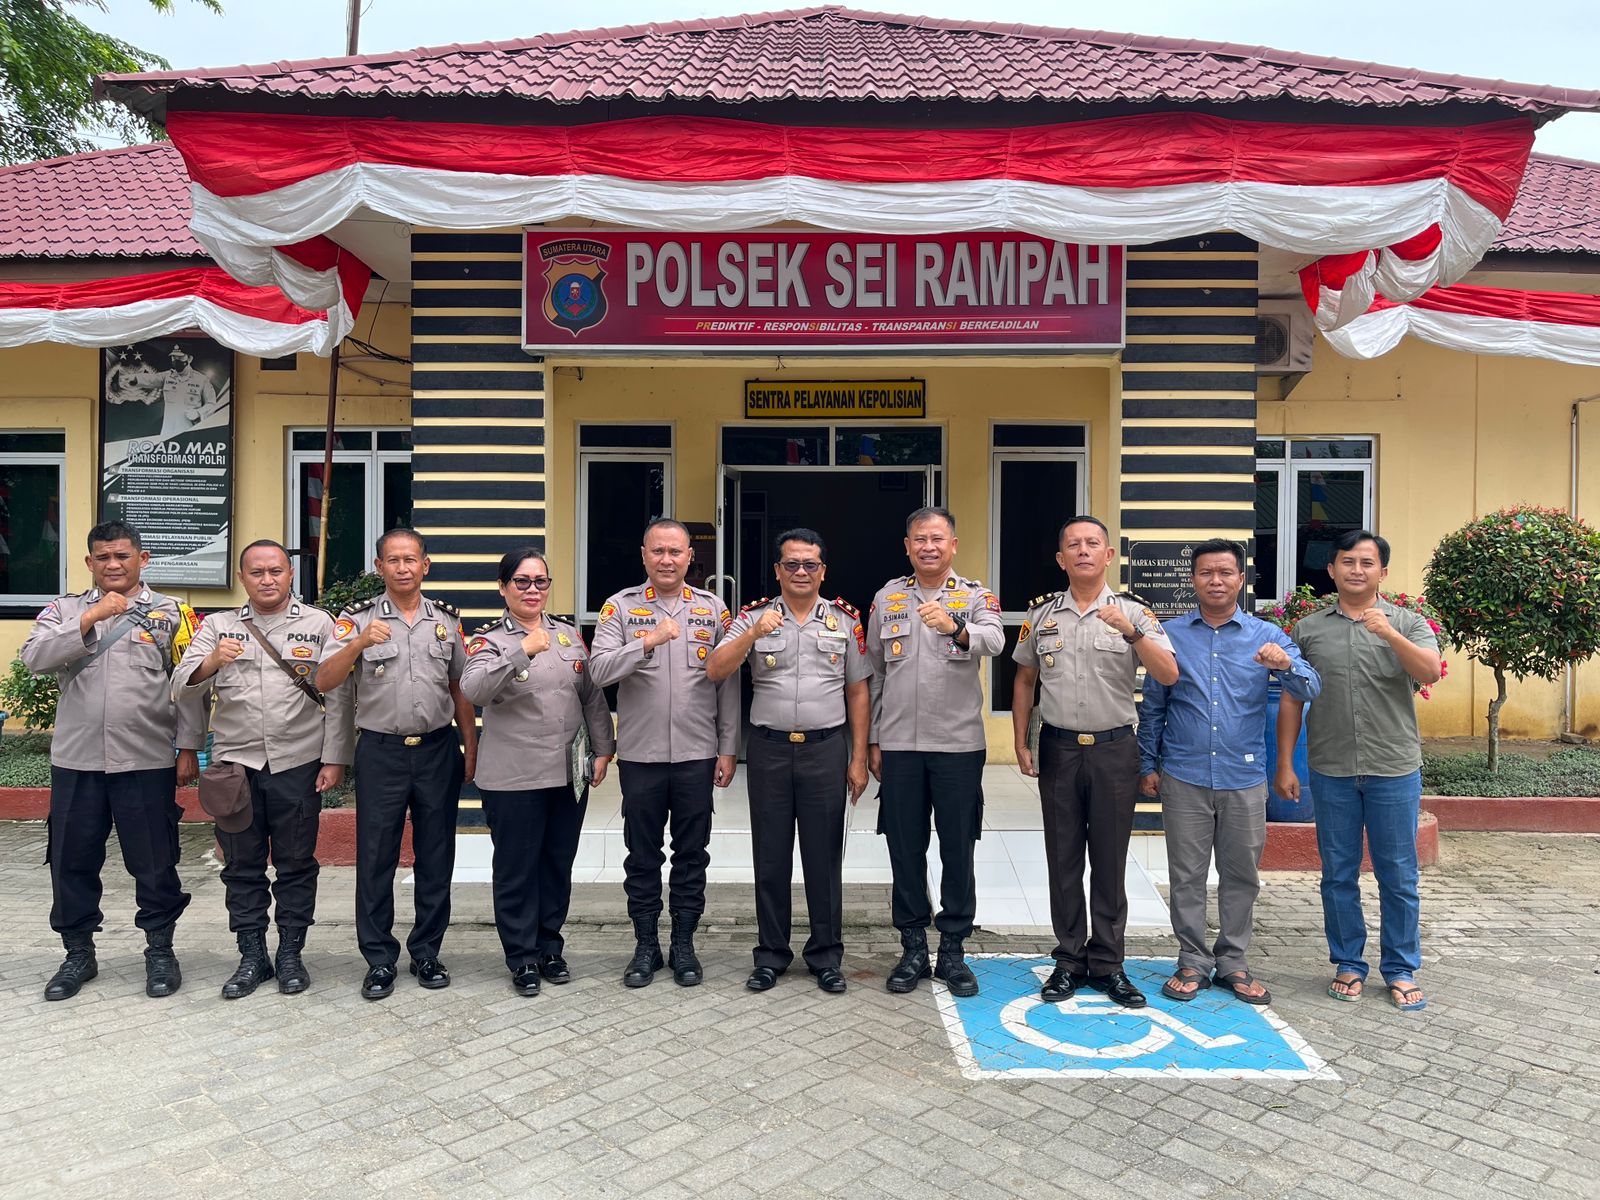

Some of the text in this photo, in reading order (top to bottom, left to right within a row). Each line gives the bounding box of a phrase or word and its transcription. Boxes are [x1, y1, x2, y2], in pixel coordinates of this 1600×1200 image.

[543, 243, 606, 256] SUMATERA UTARA
[626, 241, 1109, 308] POLSEK SEI RAMPAH
[695, 321, 756, 331] PREDIKTIF
[763, 322, 863, 331] RESPONSIBILITAS
[872, 322, 957, 331] TRANSPARANSI
[959, 320, 1039, 331] BERKEADILAN
[749, 390, 922, 409] SENTRA PELAYANAN KEPOLISIAN
[128, 441, 227, 455] ROAD MAP
[127, 453, 226, 465] TRANSFORMASI POLRI
[1131, 559, 1156, 567] MARKAS
[627, 617, 657, 626] ALBAR
[687, 618, 716, 628] POLRI
[287, 632, 320, 644] POLRI
